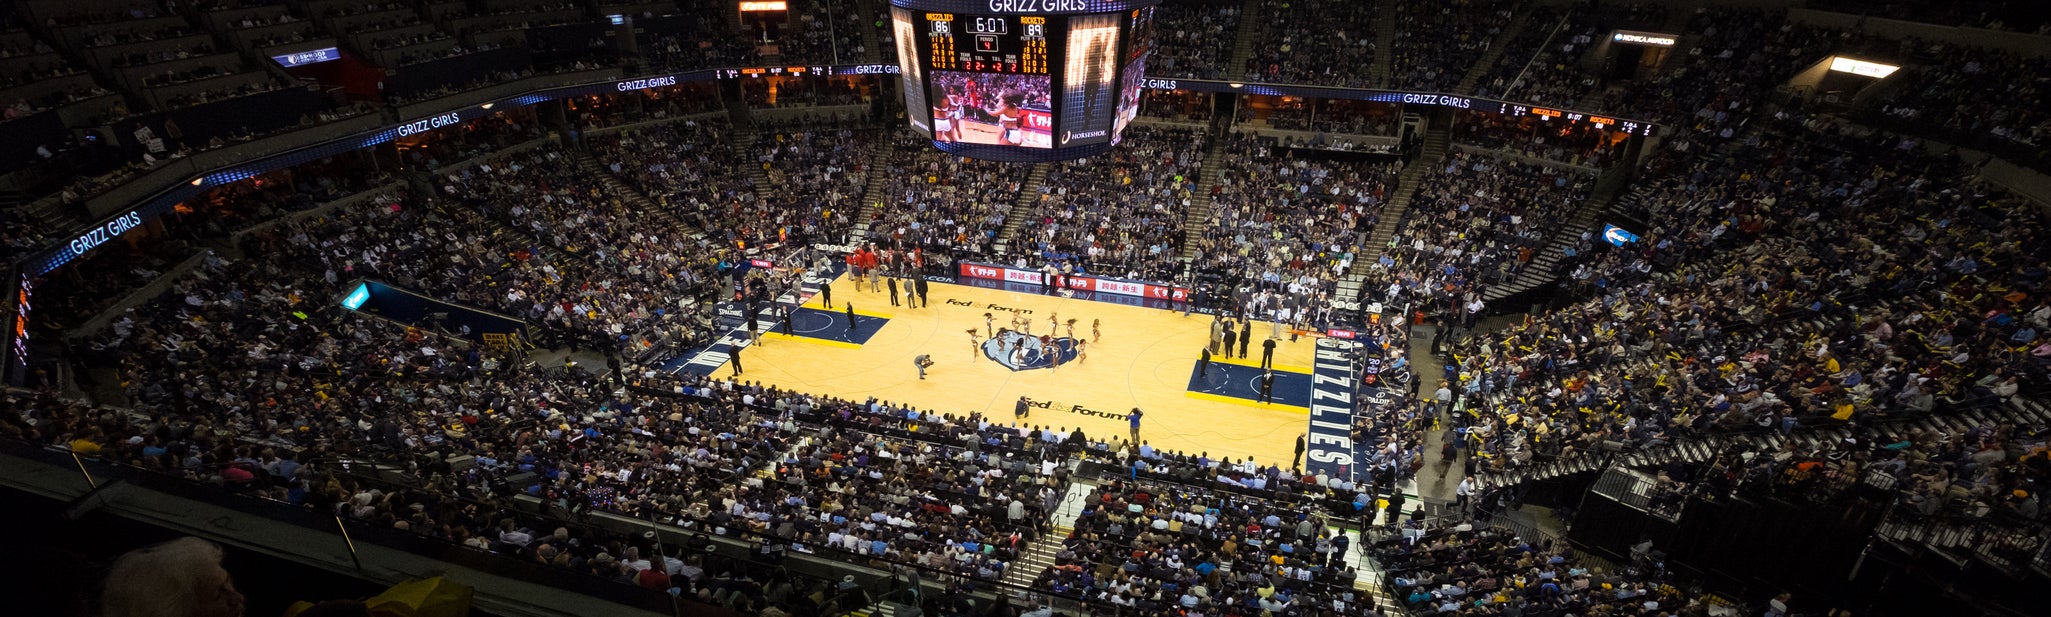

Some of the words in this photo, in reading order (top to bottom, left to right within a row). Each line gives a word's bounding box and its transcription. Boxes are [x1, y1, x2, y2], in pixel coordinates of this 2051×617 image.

[989, 0, 1037, 12] GRIZZ
[1042, 0, 1086, 12] GIRLS
[926, 12, 954, 21] GRIZZLIES
[1020, 16, 1045, 24] ROCKETS
[935, 20, 948, 32] 86
[976, 17, 1004, 32] 6:07
[1028, 24, 1041, 36] 89
[856, 65, 883, 74] GRIZZ
[885, 65, 901, 74] GIR
[618, 80, 647, 91] GRIZZ
[649, 76, 676, 87] GIRLS
[1148, 80, 1176, 89] GIRLS
[1404, 94, 1438, 104] GRIZZ
[1440, 96, 1470, 108] GIRLS
[398, 120, 430, 136] GRIZZ
[431, 112, 460, 128] GIRLS
[70, 226, 110, 254] GRIZZ
[108, 211, 141, 236] GIRLS
[1308, 338, 1352, 465] GRIZZLIES
